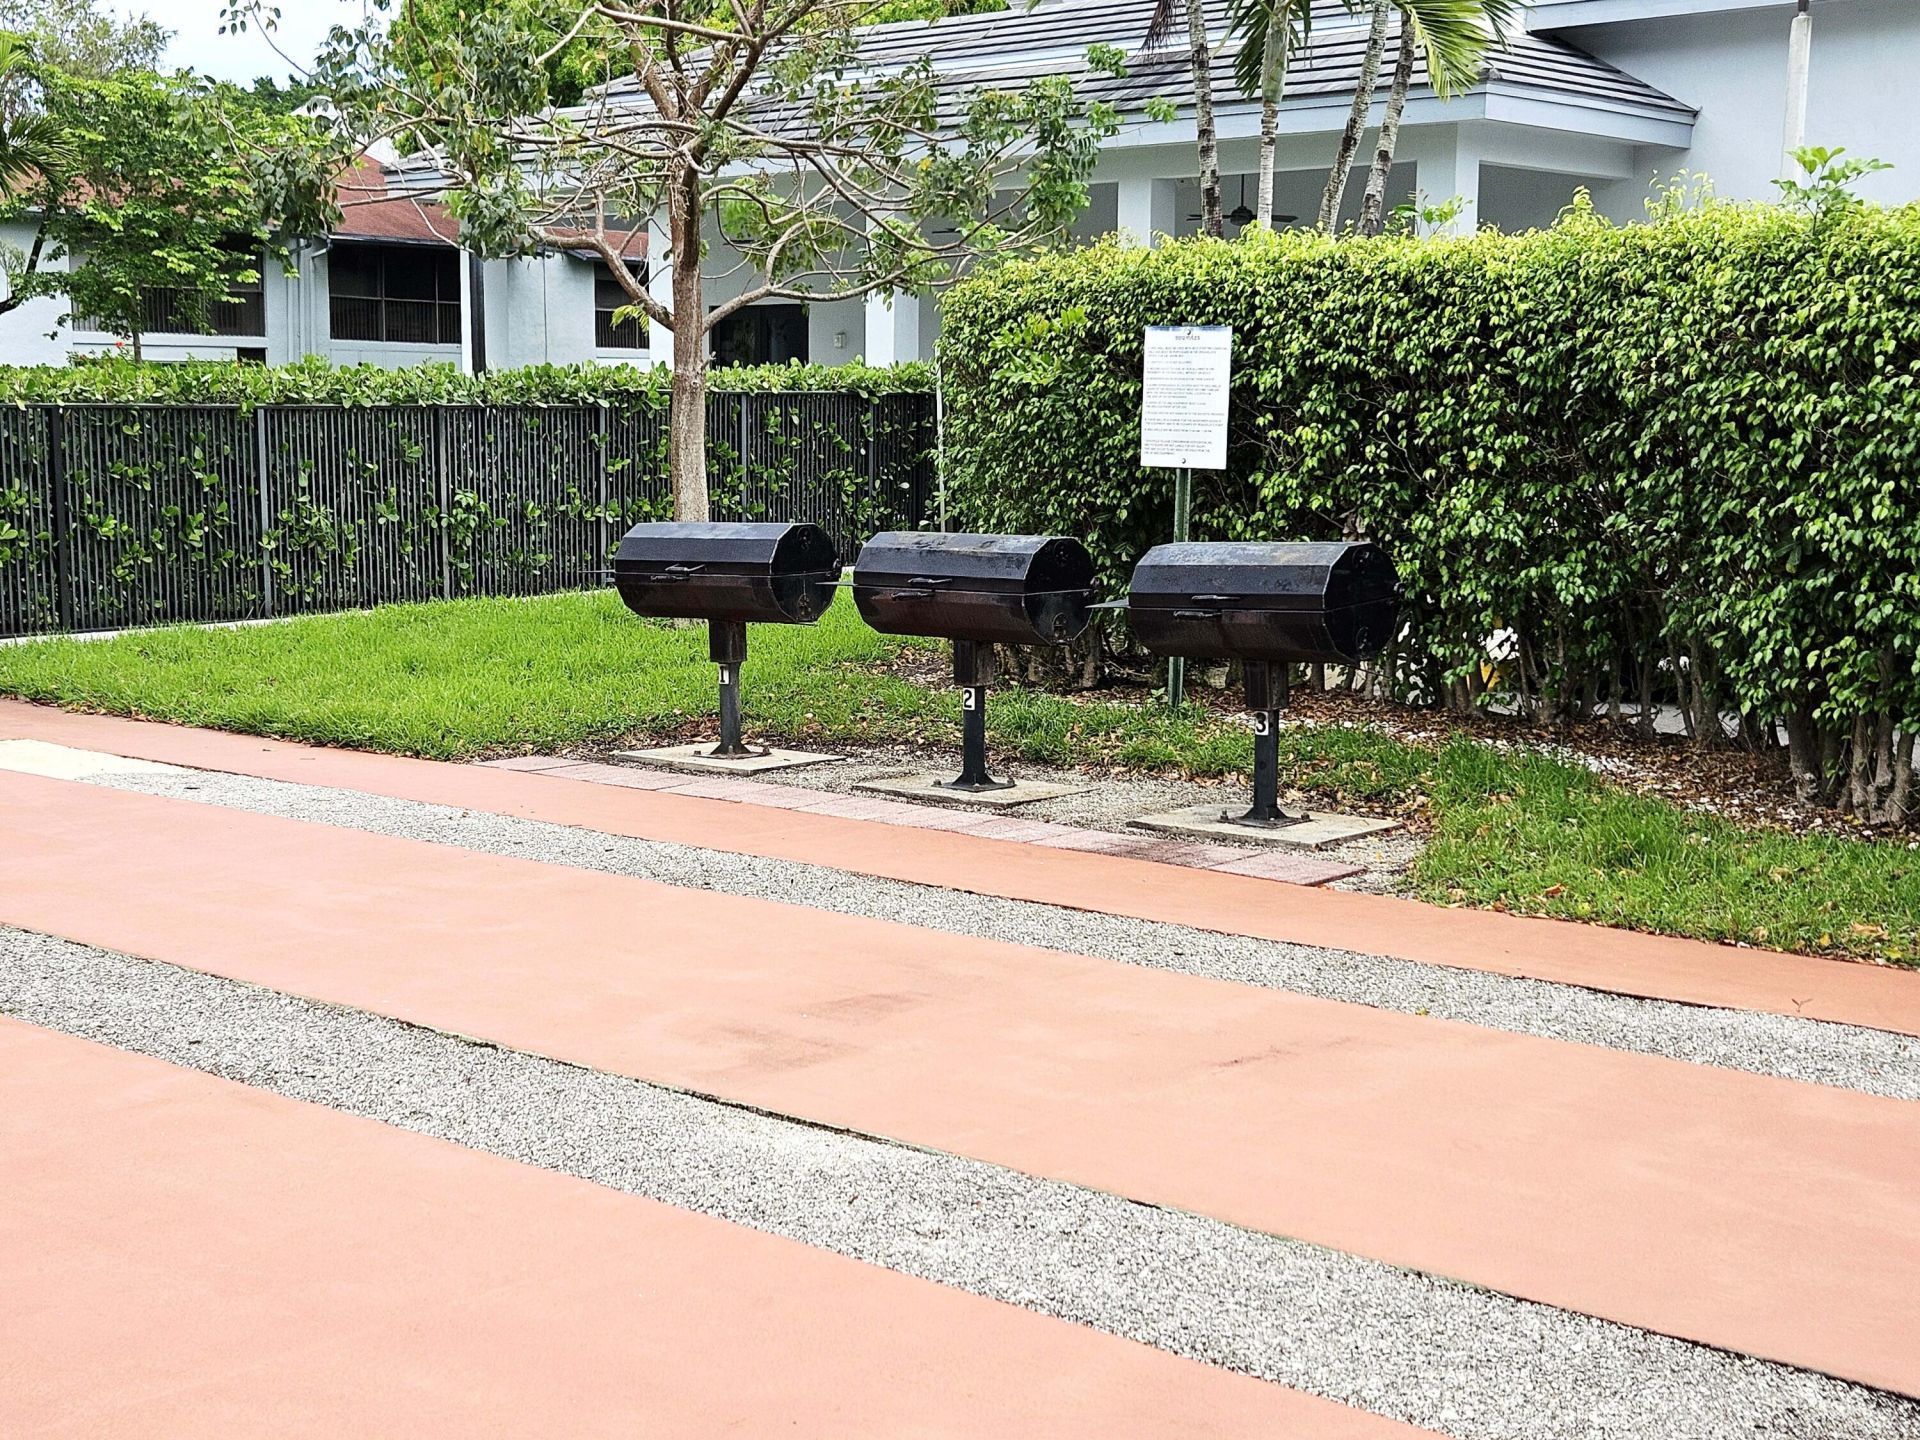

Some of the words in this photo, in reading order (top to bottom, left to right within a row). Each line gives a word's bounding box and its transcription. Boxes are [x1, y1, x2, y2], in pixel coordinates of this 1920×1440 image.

[719, 665, 726, 683] 1
[963, 689, 973, 709] 2
[1255, 712, 1267, 733] 3
